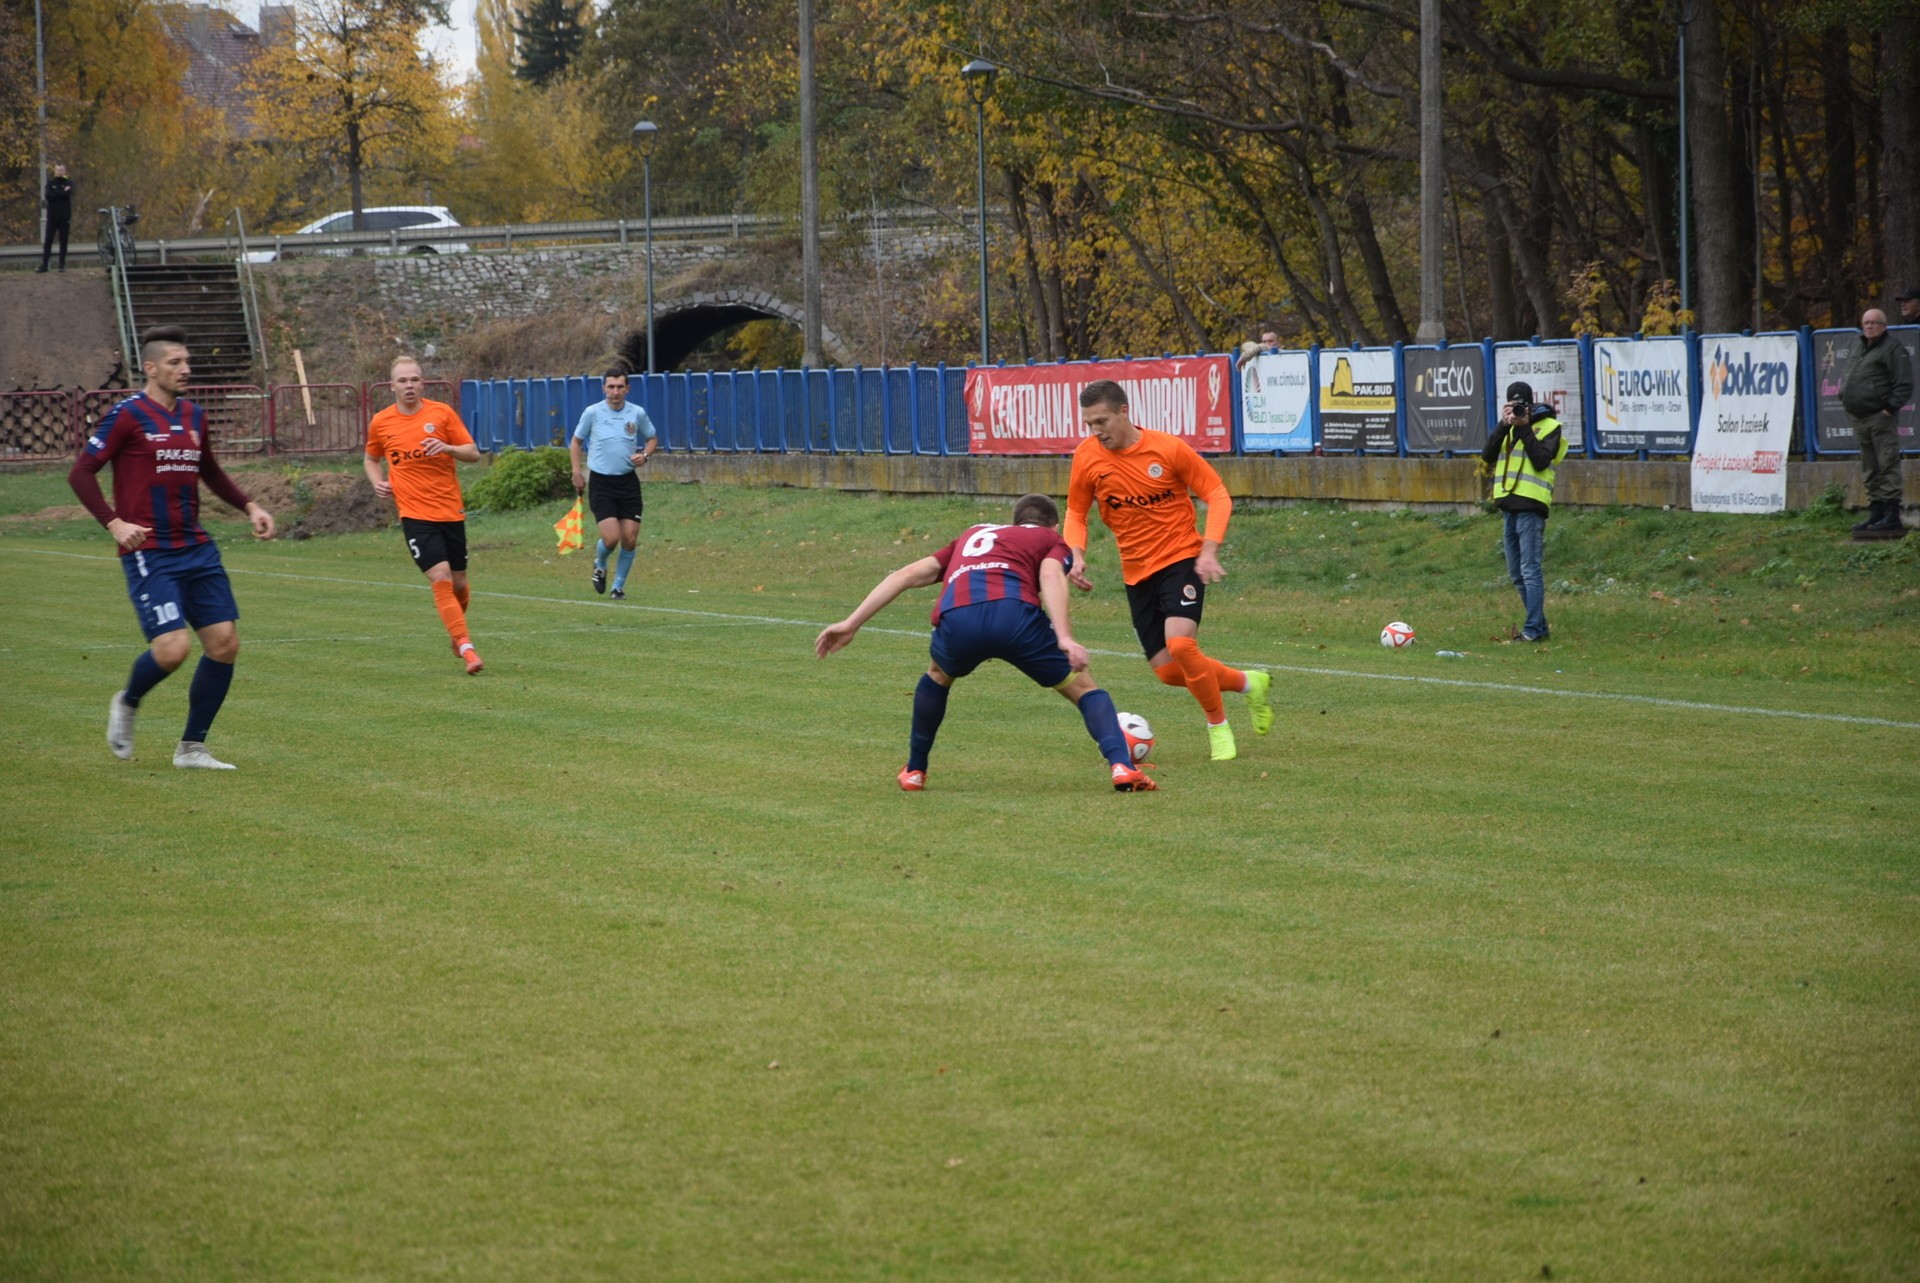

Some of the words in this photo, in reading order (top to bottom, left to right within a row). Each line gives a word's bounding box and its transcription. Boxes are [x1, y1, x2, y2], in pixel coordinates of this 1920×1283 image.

[1509, 362, 1531, 375] CENTRUM
[1533, 361, 1566, 375] BALUSTRAD
[1721, 351, 1788, 396] bokaro
[1425, 360, 1474, 398] CHEĆKO
[1353, 385, 1393, 396] PAK-BUD
[990, 383, 1075, 439] CENTRALNA
[1717, 414, 1740, 433] Salon
[1694, 453, 1722, 474] Projekt
[1125, 489, 1175, 507] KGHM
[408, 538, 421, 559] 5
[962, 526, 1001, 557] 6
[153, 601, 180, 626] 10
